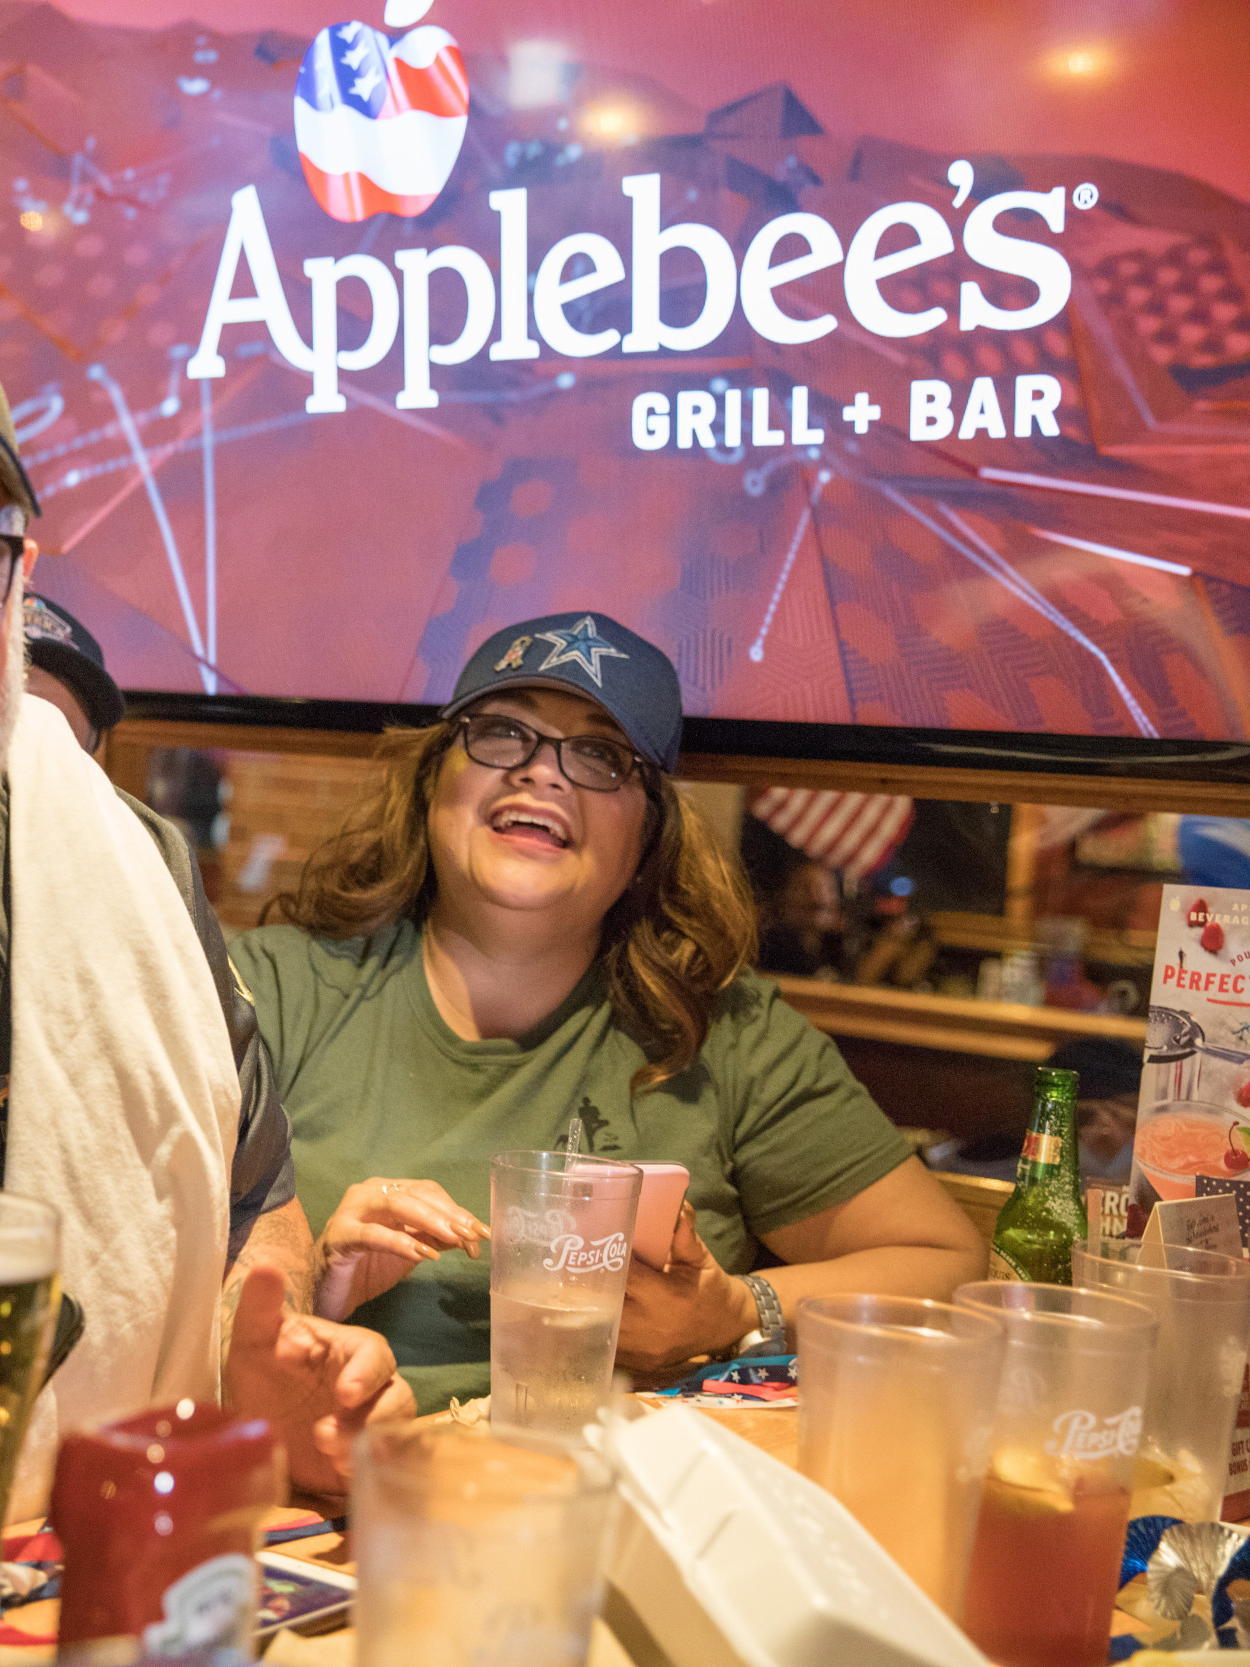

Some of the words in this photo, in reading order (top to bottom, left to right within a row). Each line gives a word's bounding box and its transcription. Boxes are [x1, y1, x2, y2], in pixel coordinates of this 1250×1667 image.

[187, 160, 1072, 413] Applebee's
[631, 386, 824, 450] GRILL
[909, 373, 1063, 442] BAR
[1163, 964, 1250, 994] PERFEC
